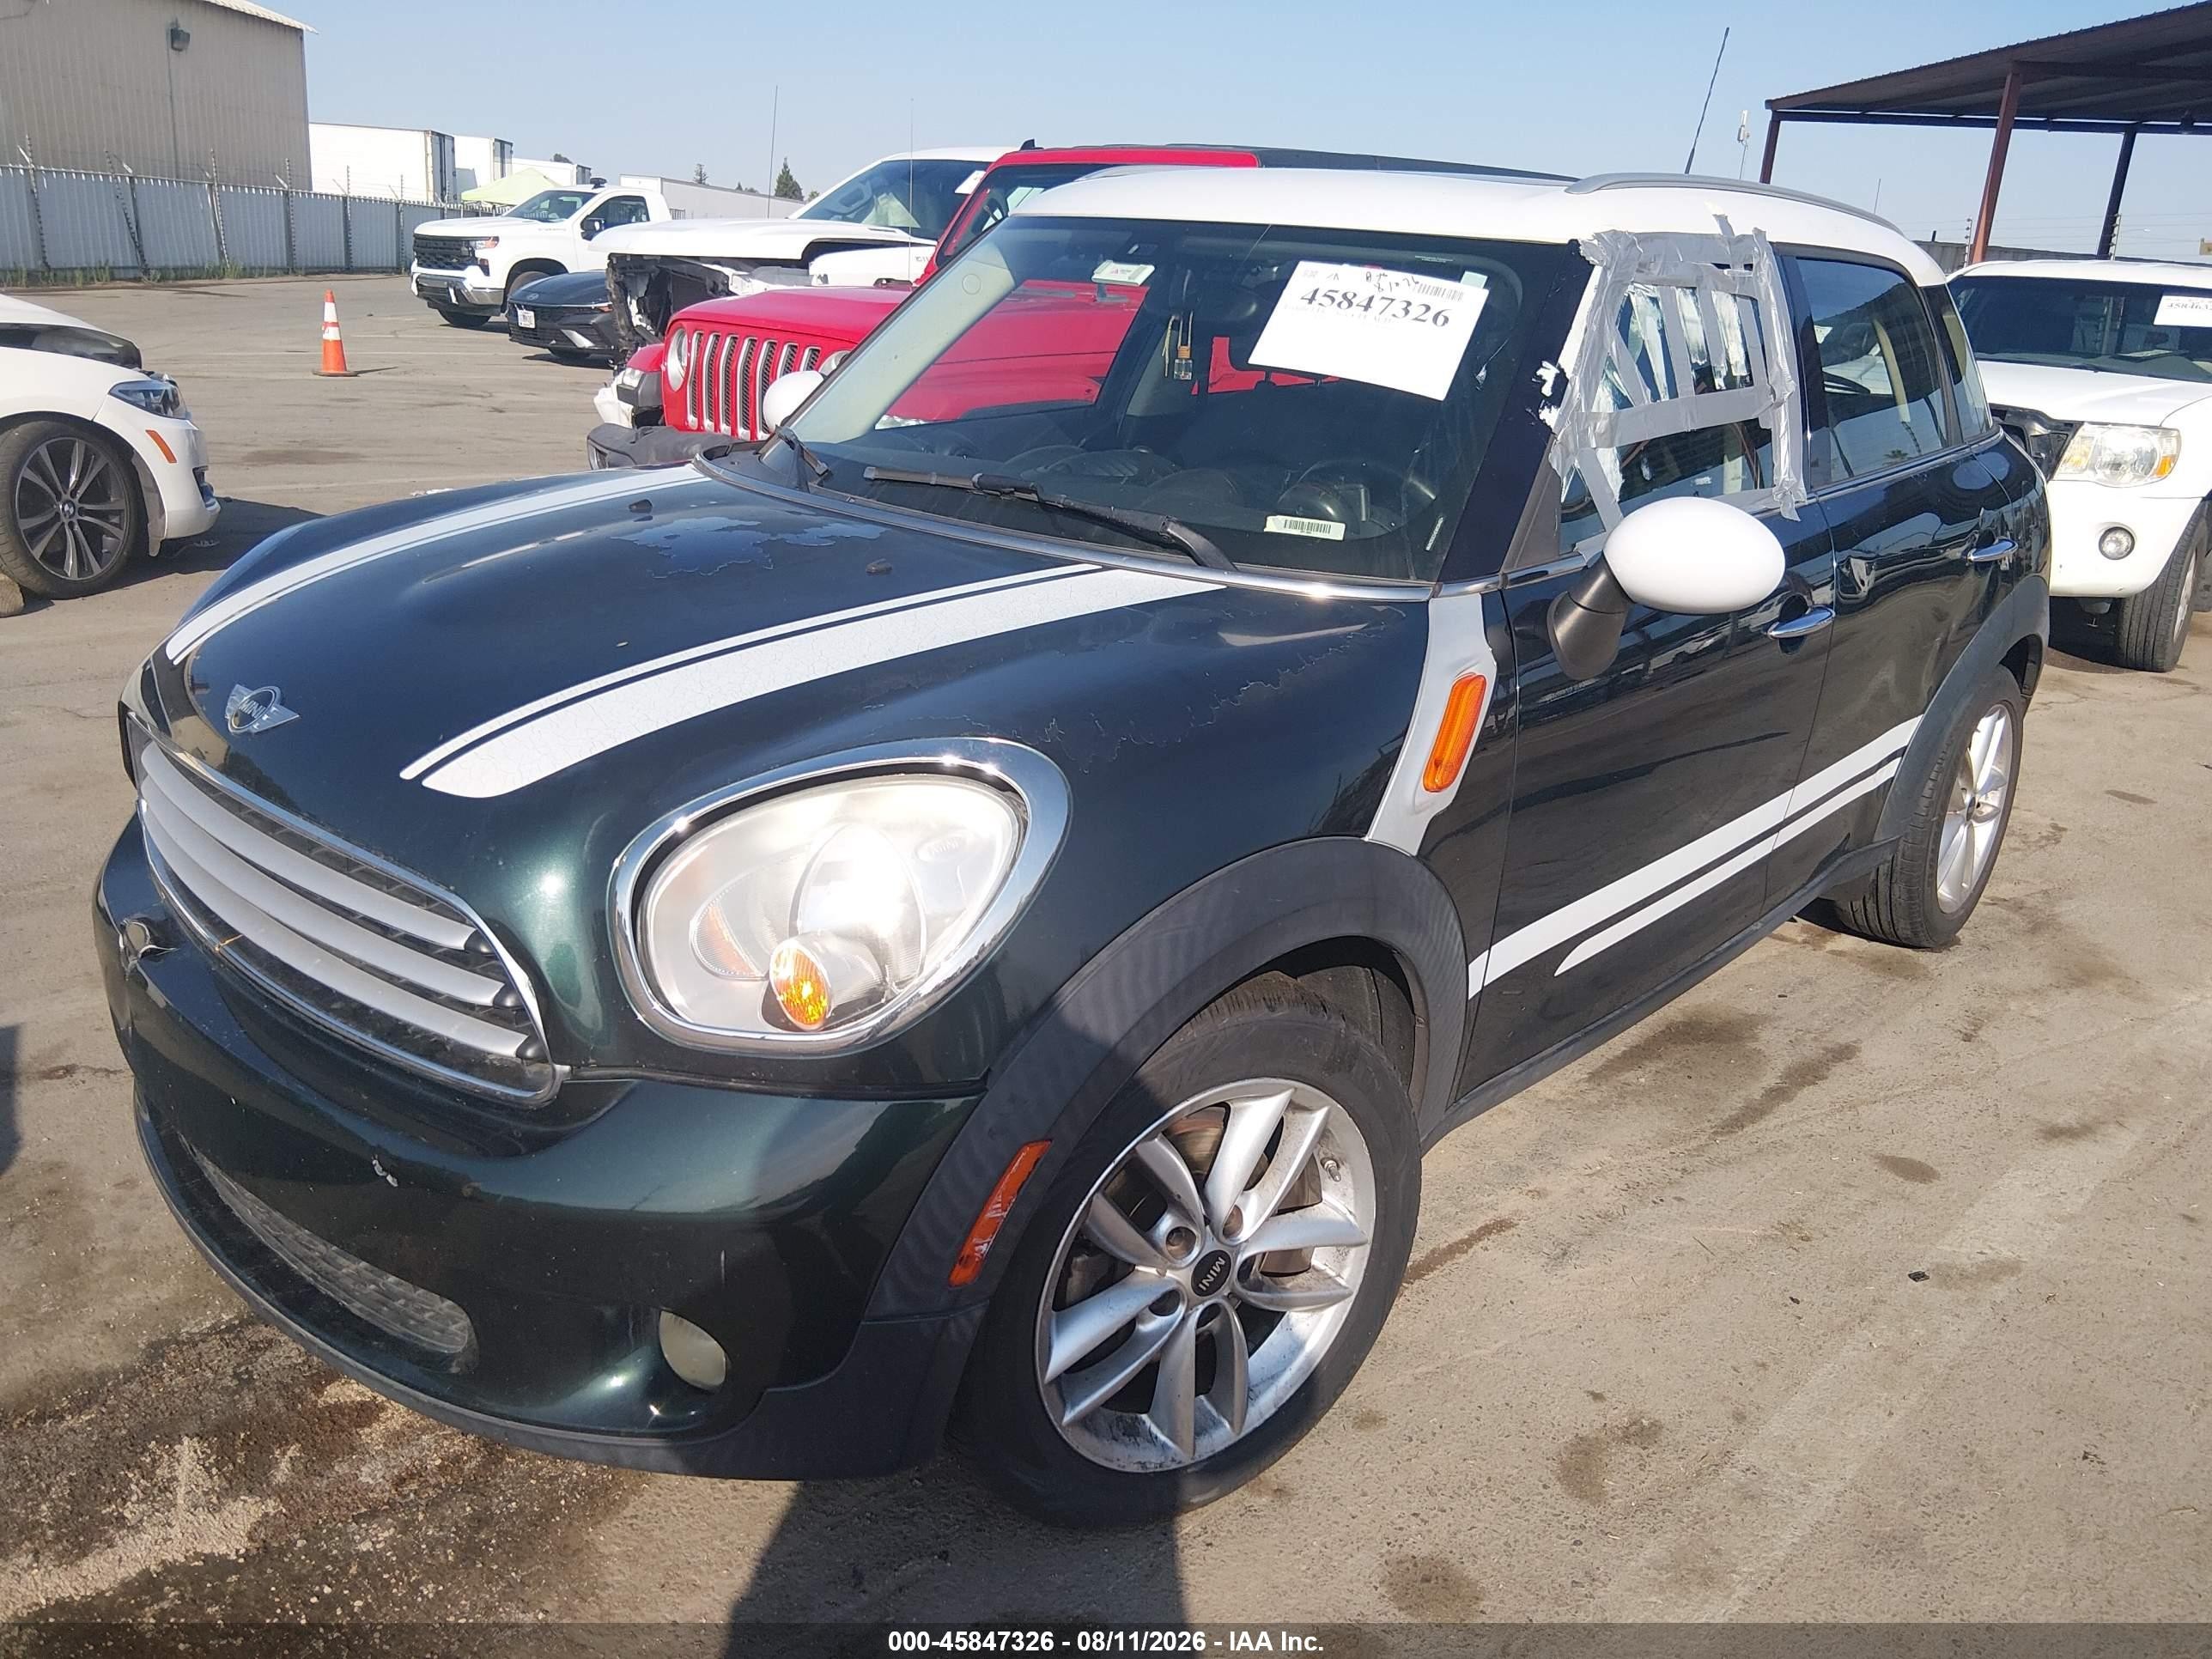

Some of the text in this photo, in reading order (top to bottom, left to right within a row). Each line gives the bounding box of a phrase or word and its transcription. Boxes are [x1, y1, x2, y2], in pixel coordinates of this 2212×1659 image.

[1299, 287, 1452, 327] 45847326
[238, 699, 266, 719] MINI
[1198, 1256, 1226, 1291] MINI
